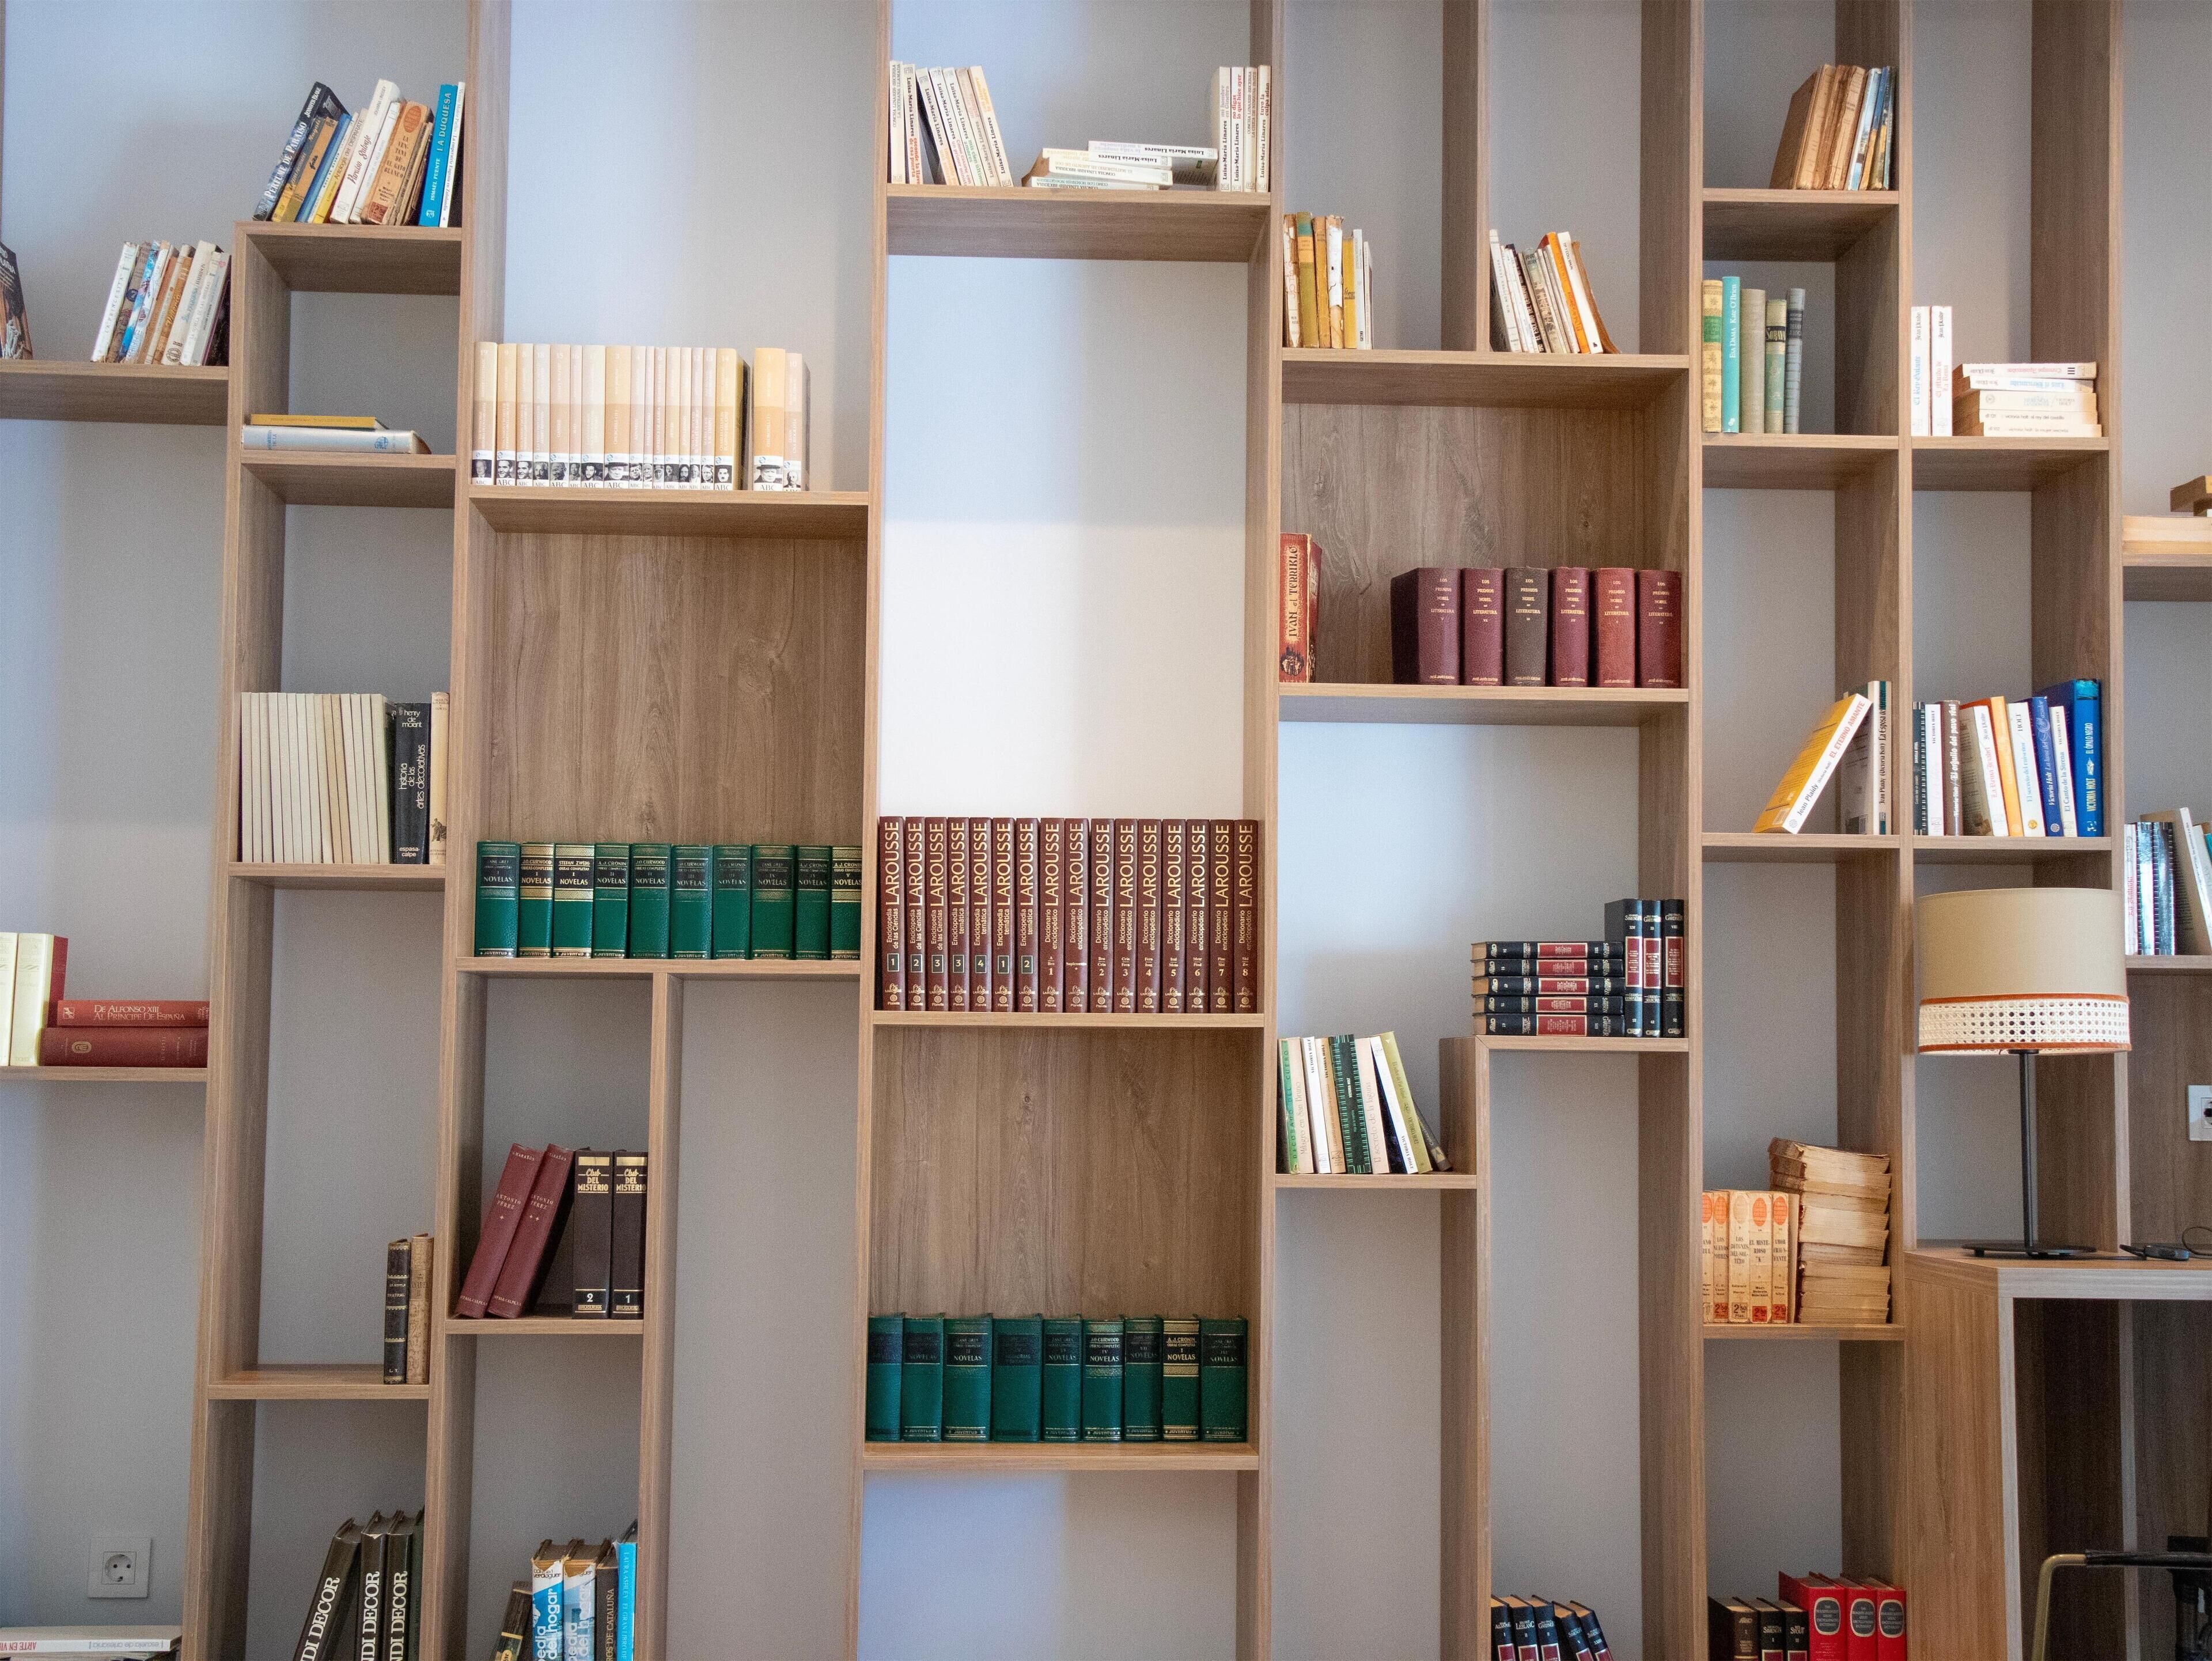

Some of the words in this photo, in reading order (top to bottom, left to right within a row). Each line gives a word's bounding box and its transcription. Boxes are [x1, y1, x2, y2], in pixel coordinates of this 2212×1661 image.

[304, 98, 315, 118] JENNIFER
[312, 87, 321, 100] BLAKE
[439, 93, 452, 138] DUQUESA
[348, 118, 365, 147] DISPARATE
[264, 165, 287, 199] PERFUME
[282, 154, 292, 167] DE
[433, 158, 441, 179] FUENTE
[430, 178, 439, 201] ISMAEL
[1766, 328, 1786, 340] SORAYA
[1289, 612, 1297, 637] IVAN
[404, 710, 421, 719] henry
[1950, 718, 1959, 734] pavo
[1829, 750, 1836, 758] EL
[1834, 726, 1851, 750] ETERNO
[1849, 701, 1865, 728] AMANTE
[1950, 736, 1959, 747] del
[2084, 722, 2093, 735] NEGRO
[415, 744, 426, 789] decorativas
[1949, 748, 1960, 771] orgullo
[399, 763, 407, 790] historia
[408, 776, 415, 787] de
[1953, 771, 1960, 780] El
[2062, 780, 2068, 788] de
[2086, 777, 2096, 790] HOLT
[416, 791, 425, 809] artes
[1797, 801, 1809, 816] Jean
[1805, 784, 1819, 802] Plaidy
[2047, 785, 2055, 805] Victoria
[2086, 790, 2097, 812] VICTORIA
[885, 822, 900, 906] LAROUSSE
[908, 823, 923, 906] LAROUSSE
[930, 823, 944, 906] LAROUSSE
[951, 823, 965, 905] LAROUSSE
[974, 823, 987, 905] LAROUSSE
[997, 823, 1010, 906] LAROUSSE
[1020, 823, 1033, 906] LAROUSSE
[1045, 824, 1059, 906] LAROUSSE
[1070, 823, 1084, 906] LAROUSSE
[1096, 824, 1109, 907] LAROUSSE
[1120, 825, 1134, 907] LAROUSSE
[1143, 825, 1157, 907] LAROUSSE
[1168, 825, 1181, 907] LAROUSSE
[1192, 825, 1205, 907] LAROUSSE
[1215, 825, 1229, 907] LAROUSSE
[1239, 825, 1252, 907] LAROUSSE
[893, 940, 899, 949] de
[108, 1005, 146, 1013] ALFONSO
[156, 1012, 186, 1021] ESPAÑA
[1289, 1110, 1298, 1159] DECORADO
[1300, 1118, 1305, 1128] en
[1300, 1128, 1309, 1155] Milagro
[1400, 1135, 1410, 1156] VICTORIA
[586, 1168, 600, 1176] Club
[624, 1168, 639, 1176] Club
[587, 1293, 593, 1302] 2
[626, 1295, 630, 1303] 1
[308, 1577, 340, 1640] DECOR
[363, 1571, 380, 1634] DECOR
[391, 1571, 408, 1634] DECOR
[548, 1588, 560, 1634] hogar
[605, 1588, 615, 1632] CATALUÑA
[1516, 1621, 1535, 1630] LEBLANC
[9, 1642, 17, 1651] EN
[18, 1641, 37, 1651] ARTE
[548, 1633, 558, 1660] del
